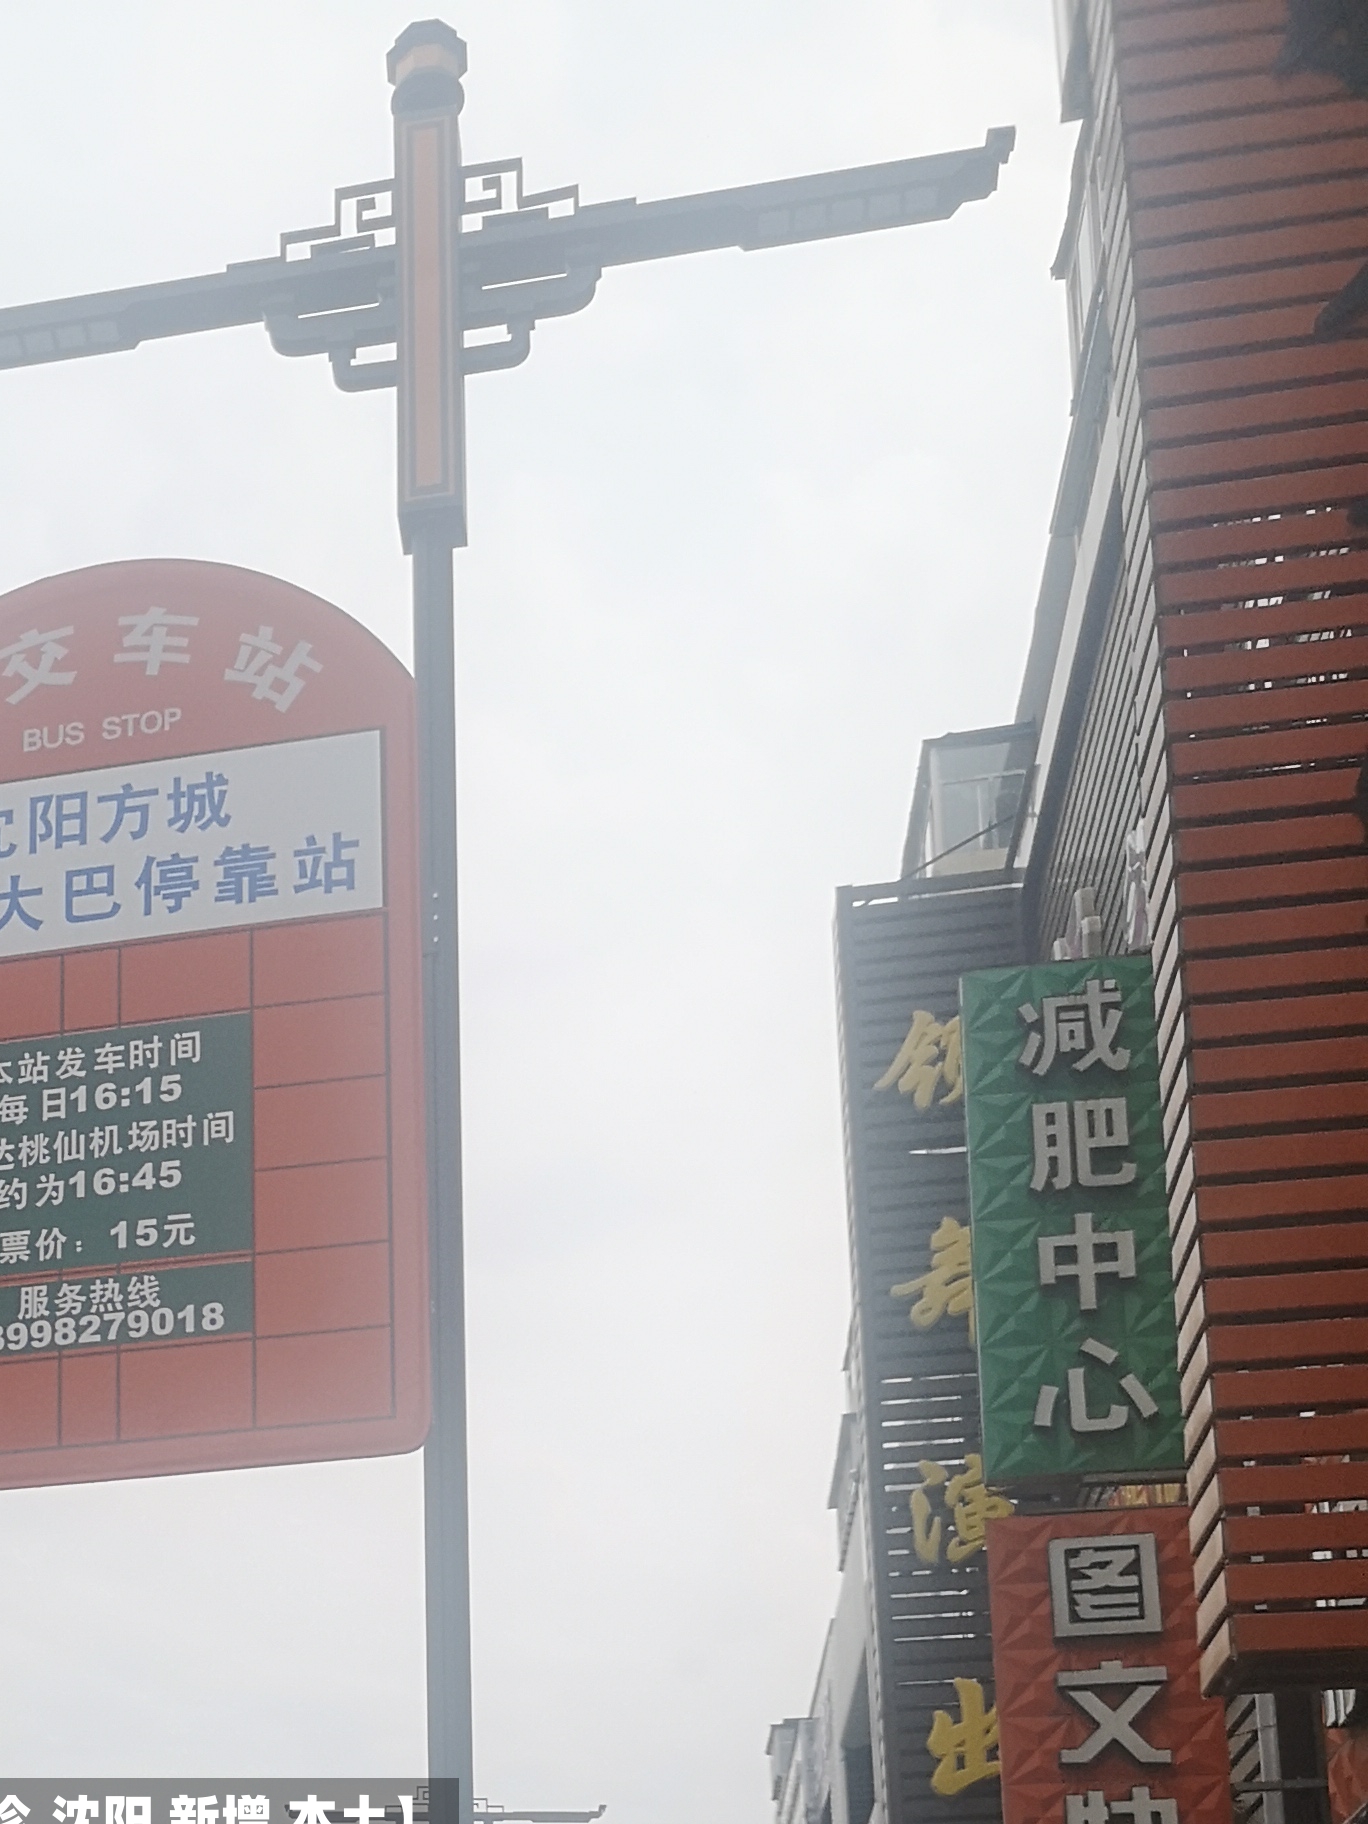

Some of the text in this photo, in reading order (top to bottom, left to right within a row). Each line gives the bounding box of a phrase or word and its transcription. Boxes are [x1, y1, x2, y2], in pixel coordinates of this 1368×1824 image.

[23, 708, 182, 752] BUS STOP
[1015, 978, 1159, 1434] 减肥中心
[18, 1275, 161, 1320] 服务热线
